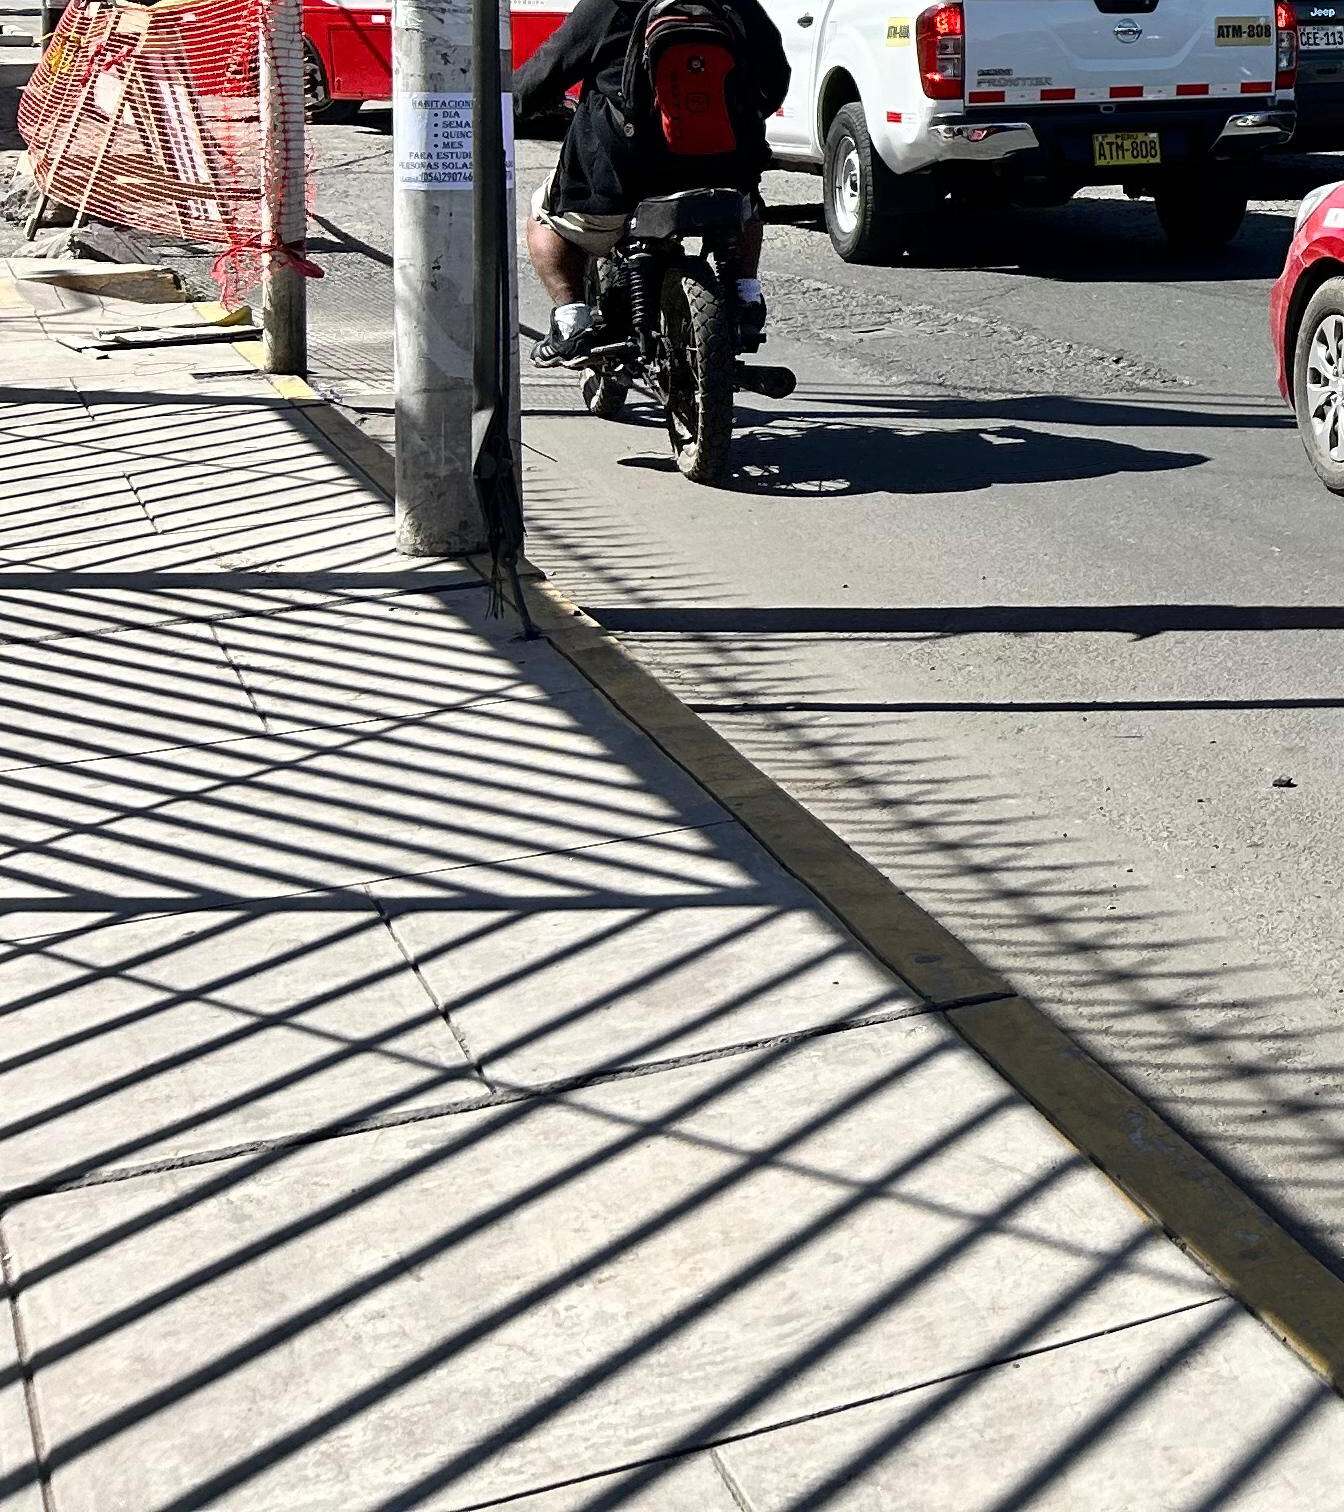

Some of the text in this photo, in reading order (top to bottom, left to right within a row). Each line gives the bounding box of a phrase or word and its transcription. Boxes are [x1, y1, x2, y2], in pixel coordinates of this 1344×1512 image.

[1310, 7, 1336, 18] Jeep
[1216, 24, 1272, 39] ATM-808
[1300, 31, 1344, 46] CEE-113
[412, 99, 473, 108] HABITACION
[442, 131, 472, 139] QUINC
[442, 141, 464, 149] MES
[1098, 140, 1158, 161] ATM-808
